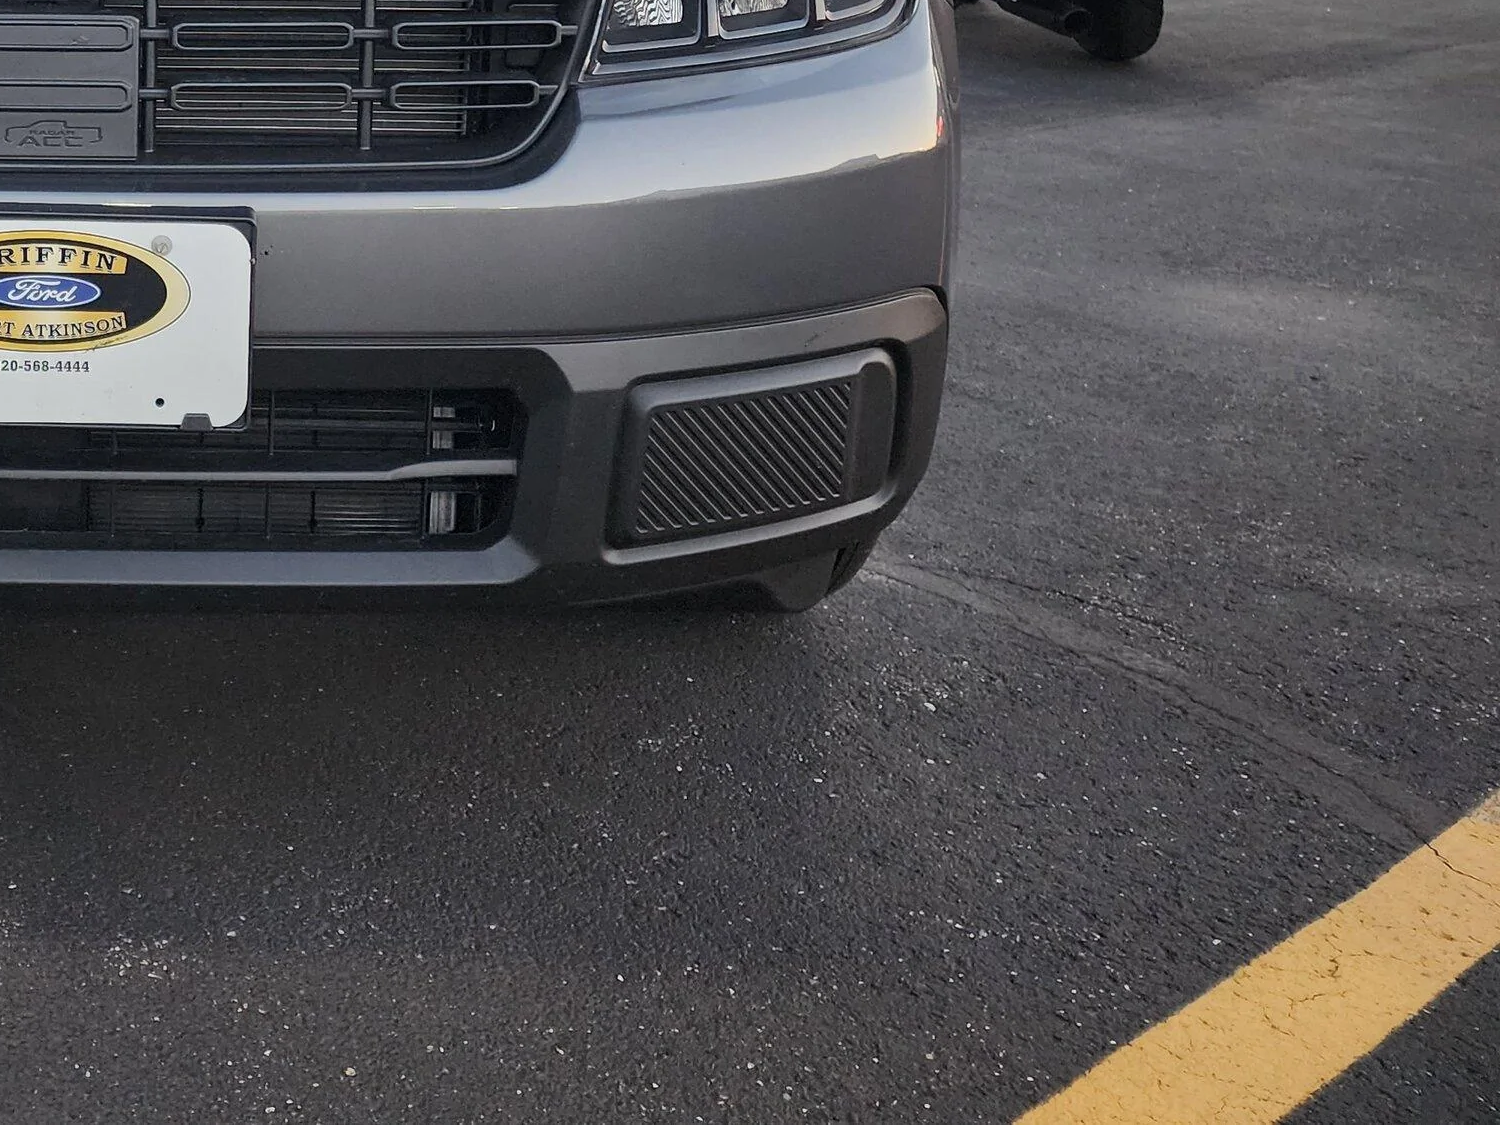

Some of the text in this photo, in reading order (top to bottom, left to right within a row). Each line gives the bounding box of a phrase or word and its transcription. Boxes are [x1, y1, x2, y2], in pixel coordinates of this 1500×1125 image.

[18, 136, 83, 147] ACC
[8, 279, 78, 302] Ford
[21, 315, 124, 338] ATKINSON
